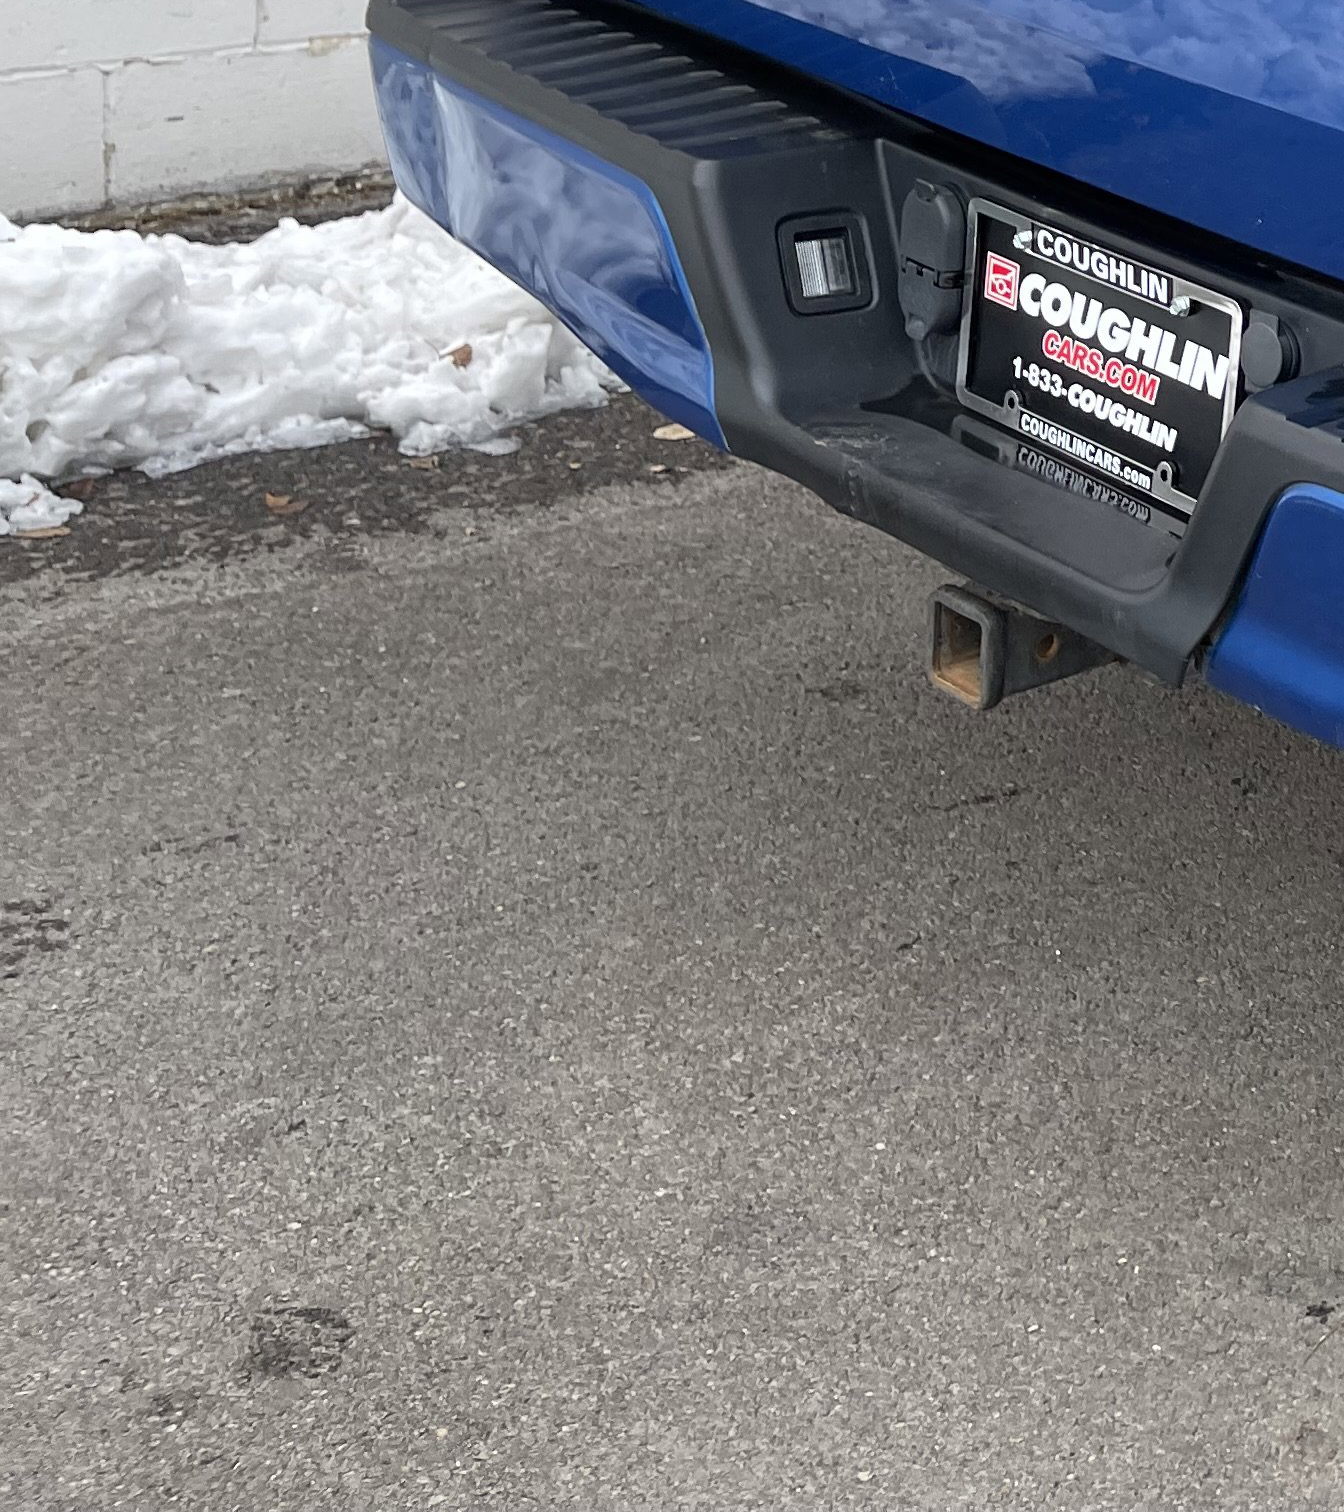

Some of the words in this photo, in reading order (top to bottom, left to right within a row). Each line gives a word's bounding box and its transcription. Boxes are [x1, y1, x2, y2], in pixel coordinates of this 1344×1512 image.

[1036, 230, 1169, 304] COUGHLIN
[1018, 273, 1230, 400] COUGHLIN
[1042, 330, 1161, 405] CARS.COM
[1012, 355, 1178, 452] 1-833-COUGHLIN
[1020, 412, 1152, 491] COUGHLINCARS.com
